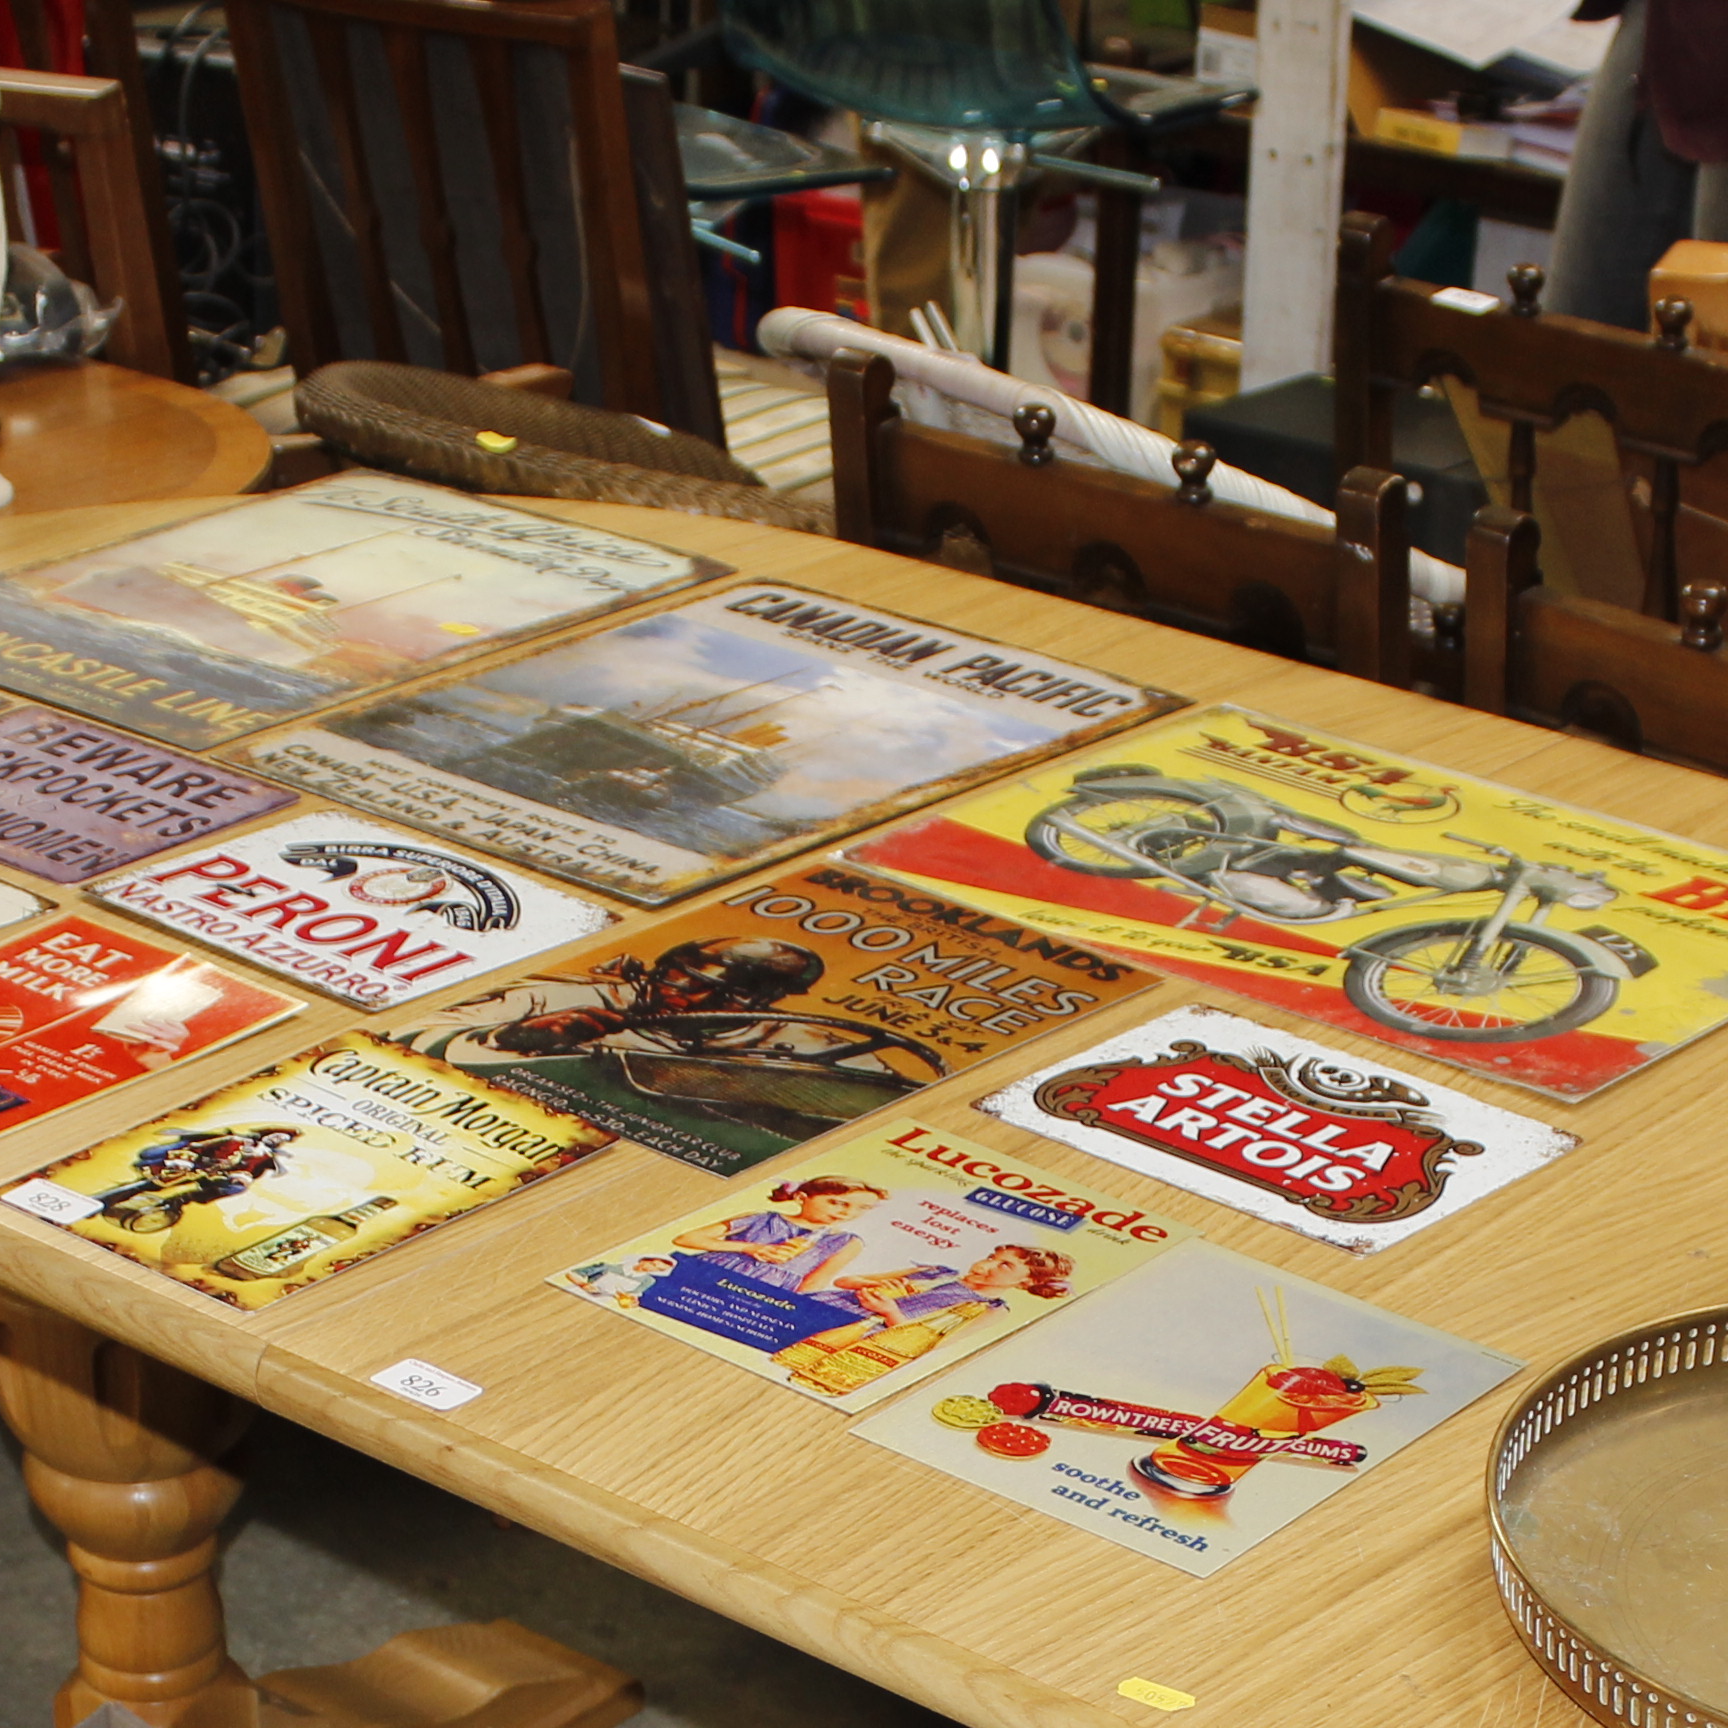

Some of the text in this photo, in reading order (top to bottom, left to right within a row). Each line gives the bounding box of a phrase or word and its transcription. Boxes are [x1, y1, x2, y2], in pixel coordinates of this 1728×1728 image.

[354, 495, 507, 526] South
[725, 591, 1133, 717] CANADIAN PACIFIC
[781, 629, 1006, 699] SPANS THE WORLD
[151, 689, 273, 737] LINE
[2, 722, 250, 810] BEWARE
[1244, 717, 1417, 785] BSA
[258, 751, 317, 779] NEW
[314, 773, 444, 823] ZEALAND
[1494, 799, 1664, 847] The small
[324, 844, 485, 883] BIRRA SUPERIORE
[1542, 840, 1664, 877] with the
[113, 881, 391, 1001] NASTRO AZZURRO
[145, 853, 478, 988] PERONI
[802, 867, 1134, 984] BROOKLANDS
[859, 904, 1002, 958] THE BRITISH
[15, 947, 111, 988] MORE
[39, 932, 135, 969] EAT
[723, 884, 1101, 1018] 1000 MILES
[1207, 939, 1333, 978] BSA
[821, 992, 919, 1032] JUNE
[851, 962, 1045, 1036] RACE
[306, 1047, 563, 1165] Captain Morgan
[351, 1097, 453, 1147] ORIGINAL
[1157, 1072, 1395, 1173] STELLA
[257, 1086, 496, 1191] SPICED RUM
[620, 1109, 744, 1163] JUNIOR CLUB
[631, 1131, 726, 1171] EACH DAY
[1106, 1094, 1368, 1193] ARTOIS
[26, 1190, 70, 1213] 828
[884, 1126, 1170, 1243] Lucozade
[973, 1189, 1077, 1227] GLUCOSE
[890, 1218, 962, 1251] energy
[917, 1199, 1001, 1236] replaces
[921, 1216, 962, 1237] lost
[1085, 1225, 1134, 1246] drink
[715, 1278, 797, 1311] Lucozade
[400, 1375, 448, 1397] 826
[1052, 1399, 1355, 1461] ROWNTREE'S FRUIT GUMS
[1049, 1458, 1142, 1502] soothe
[1049, 1480, 1211, 1556] and refresh
